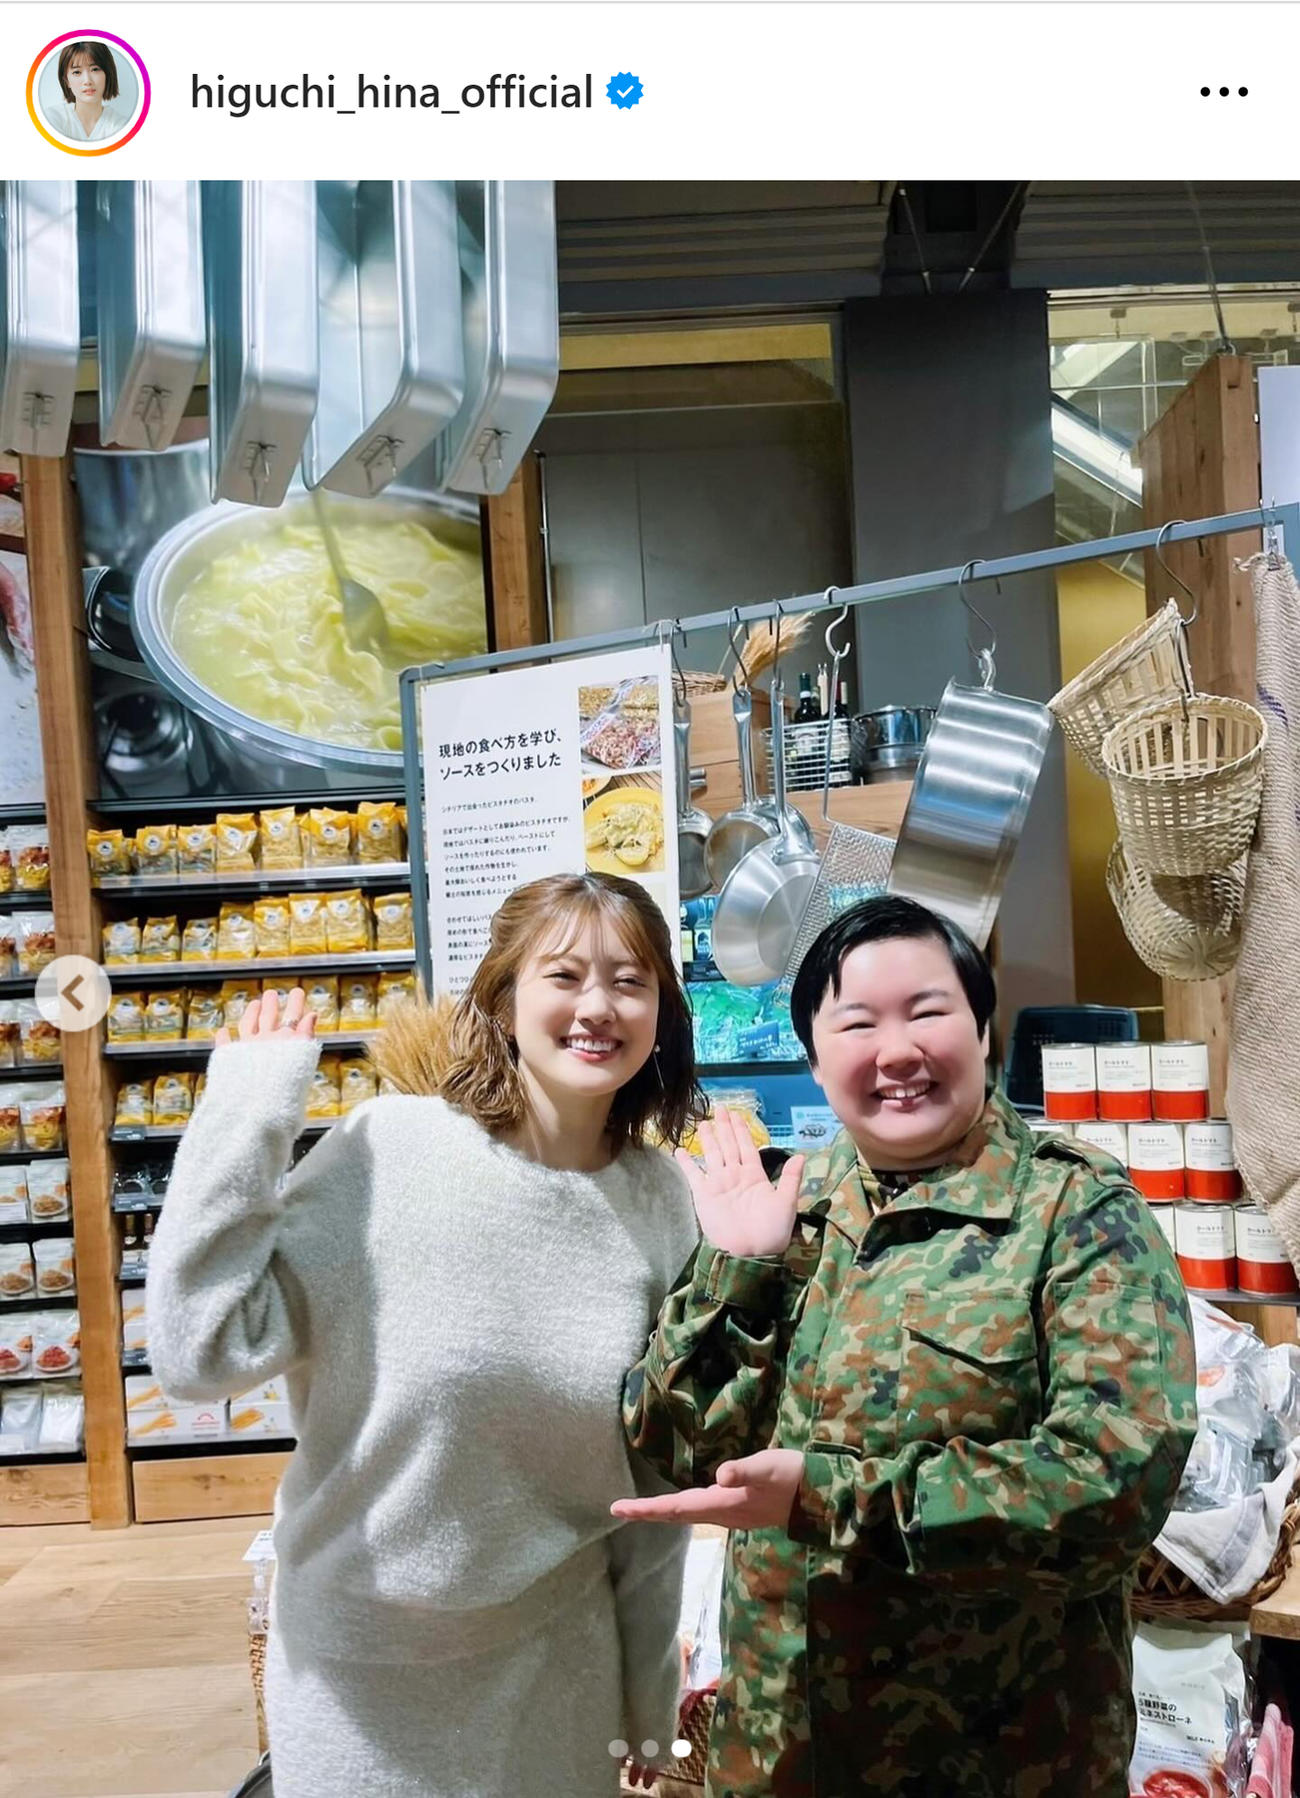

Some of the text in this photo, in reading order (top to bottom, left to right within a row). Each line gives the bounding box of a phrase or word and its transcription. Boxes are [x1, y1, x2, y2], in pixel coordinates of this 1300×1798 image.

[439, 728, 561, 759] 現地の食べ方を学び、
[440, 752, 561, 780] ソースをつくりました
